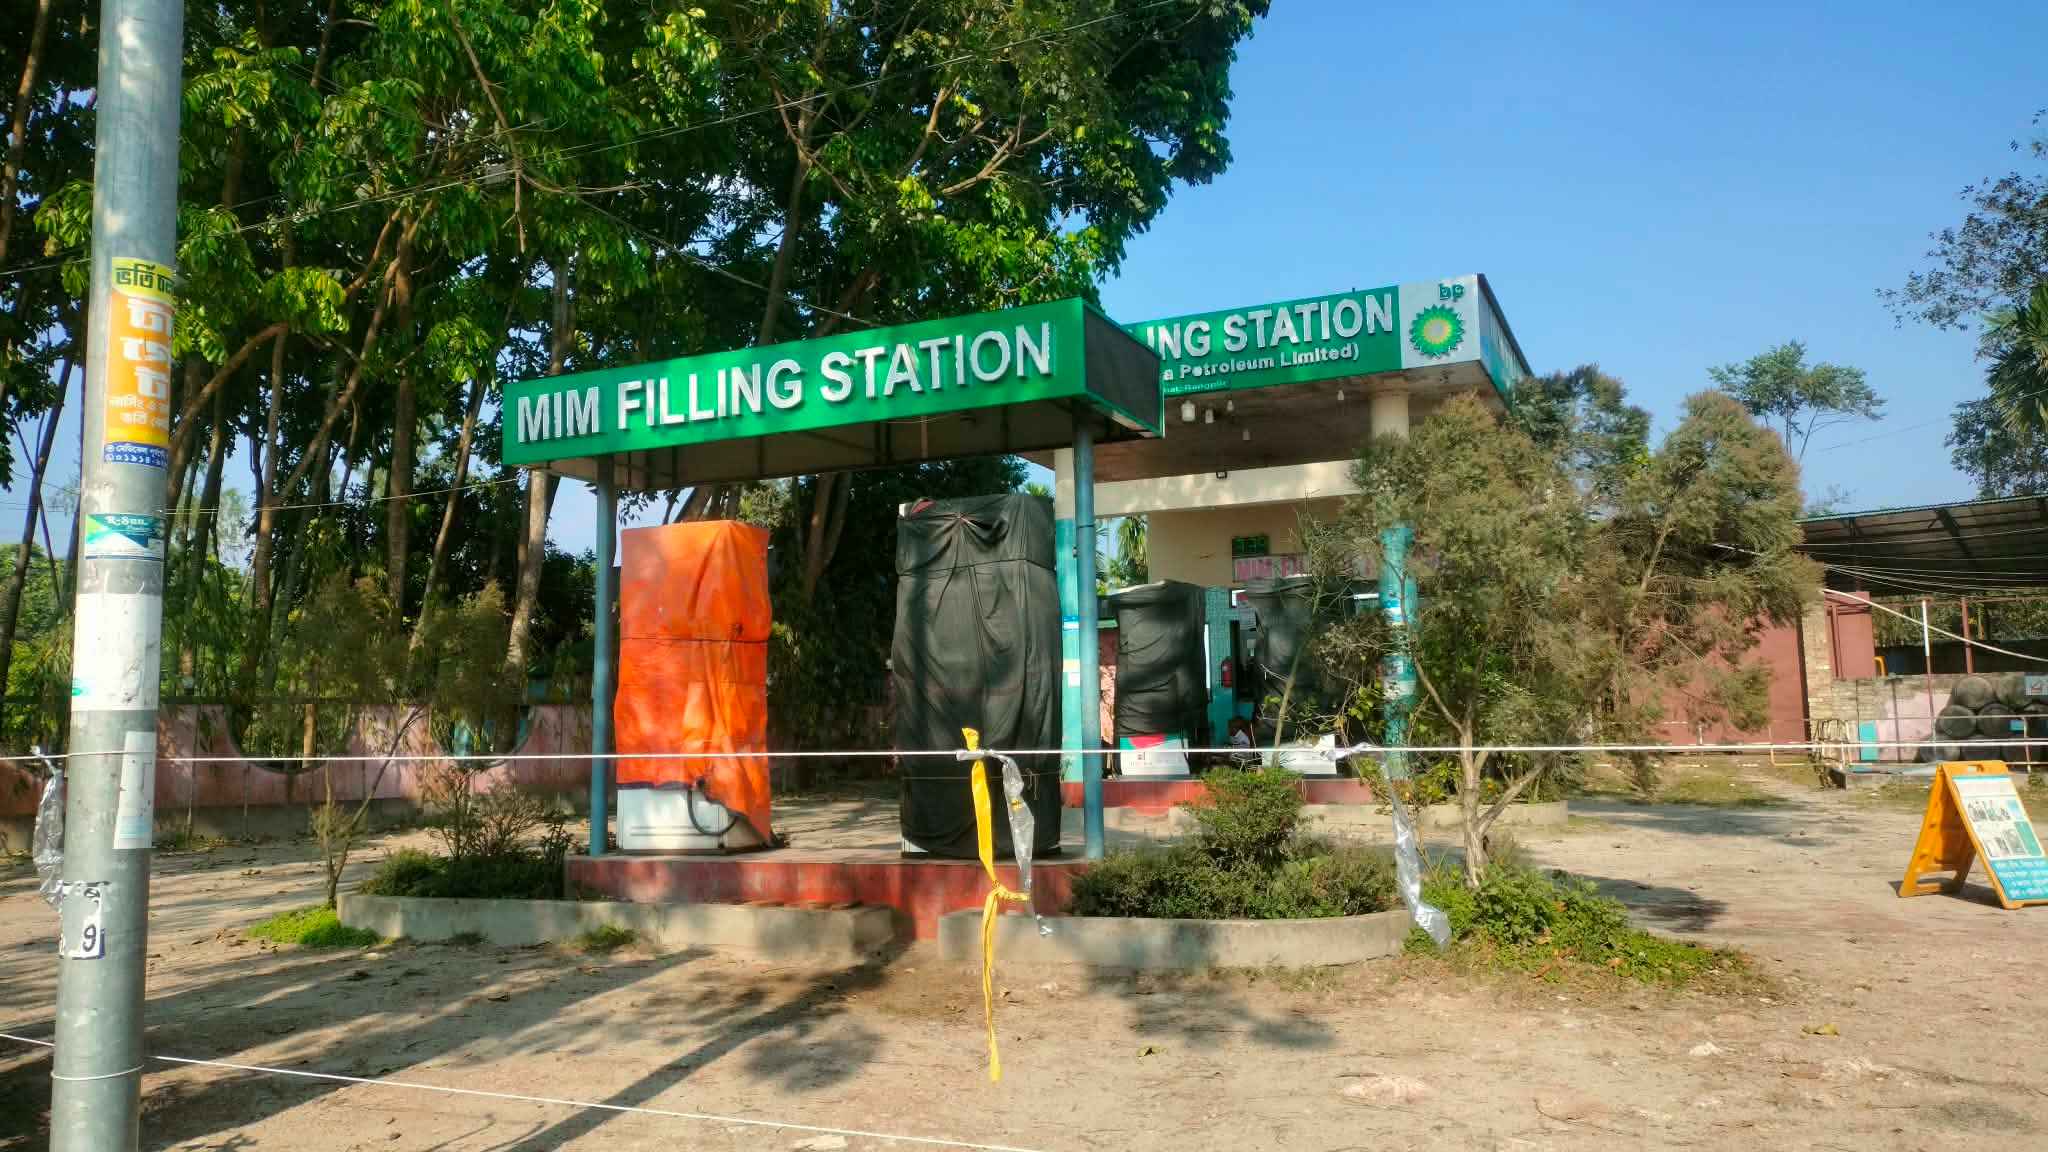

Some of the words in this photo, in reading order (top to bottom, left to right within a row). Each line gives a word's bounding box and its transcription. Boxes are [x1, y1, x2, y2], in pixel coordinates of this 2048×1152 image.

[1223, 293, 1393, 352] STATION
[517, 385, 600, 443] MIM
[616, 358, 802, 429] FILLING
[820, 321, 1051, 401] STATION
[1180, 356, 1275, 379] Petroleum
[1280, 343, 1359, 367] Limited)
